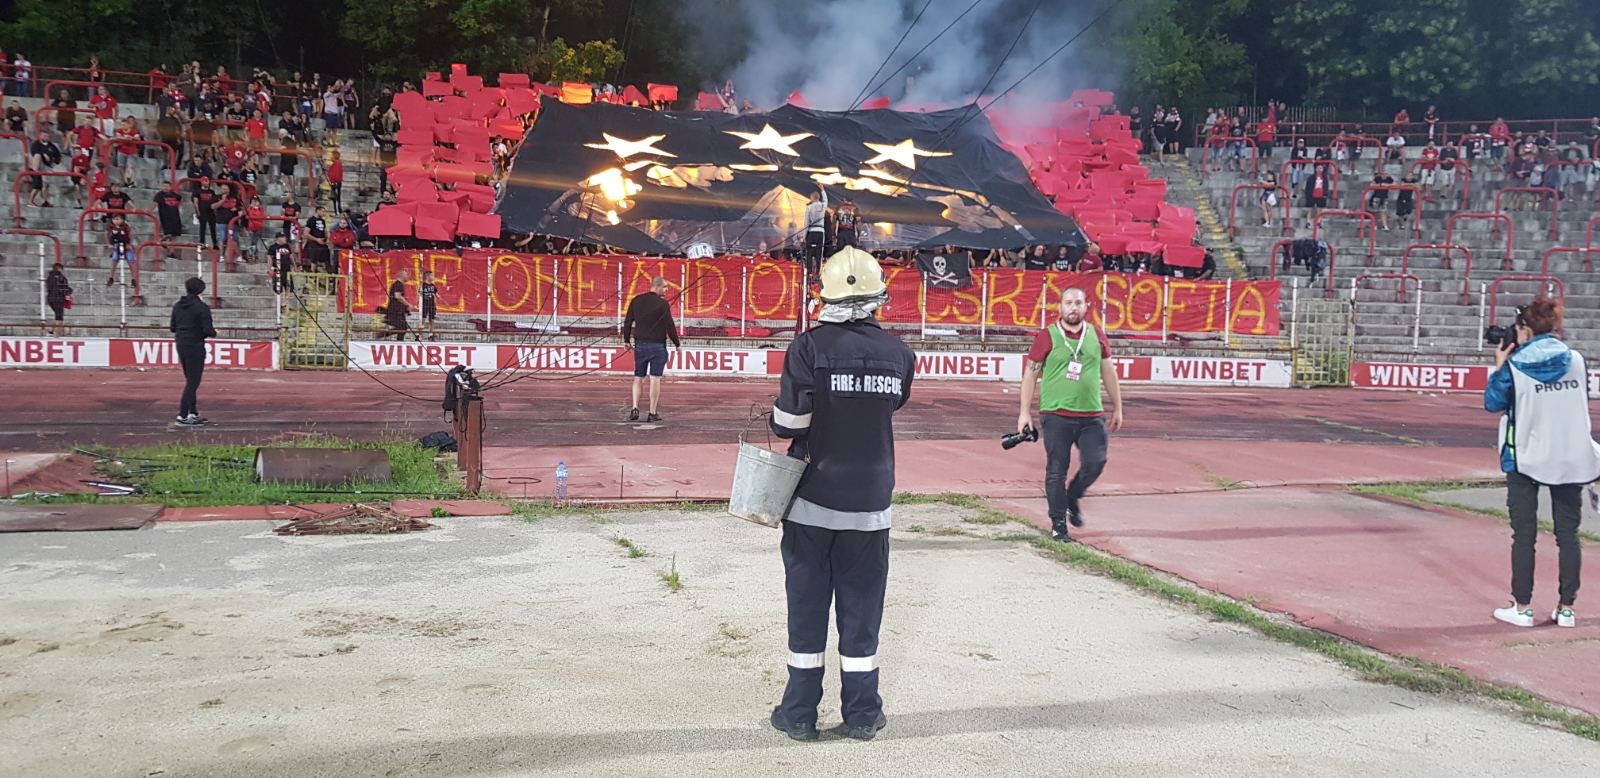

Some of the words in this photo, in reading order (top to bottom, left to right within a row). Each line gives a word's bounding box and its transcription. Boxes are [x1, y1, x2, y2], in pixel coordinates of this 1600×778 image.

[490, 255, 607, 314] ONE
[1093, 275, 1266, 334] SOFIA
[371, 345, 476, 366] WINBET
[516, 347, 617, 369] WINBET
[914, 355, 1004, 375] WINBET
[1170, 360, 1266, 381] WINBET
[1369, 365, 1470, 388] WINBET
[831, 374, 854, 391] FIRE
[855, 377, 862, 391] &
[864, 375, 902, 395] RESCUE
[1535, 380, 1579, 393] PHOTO
